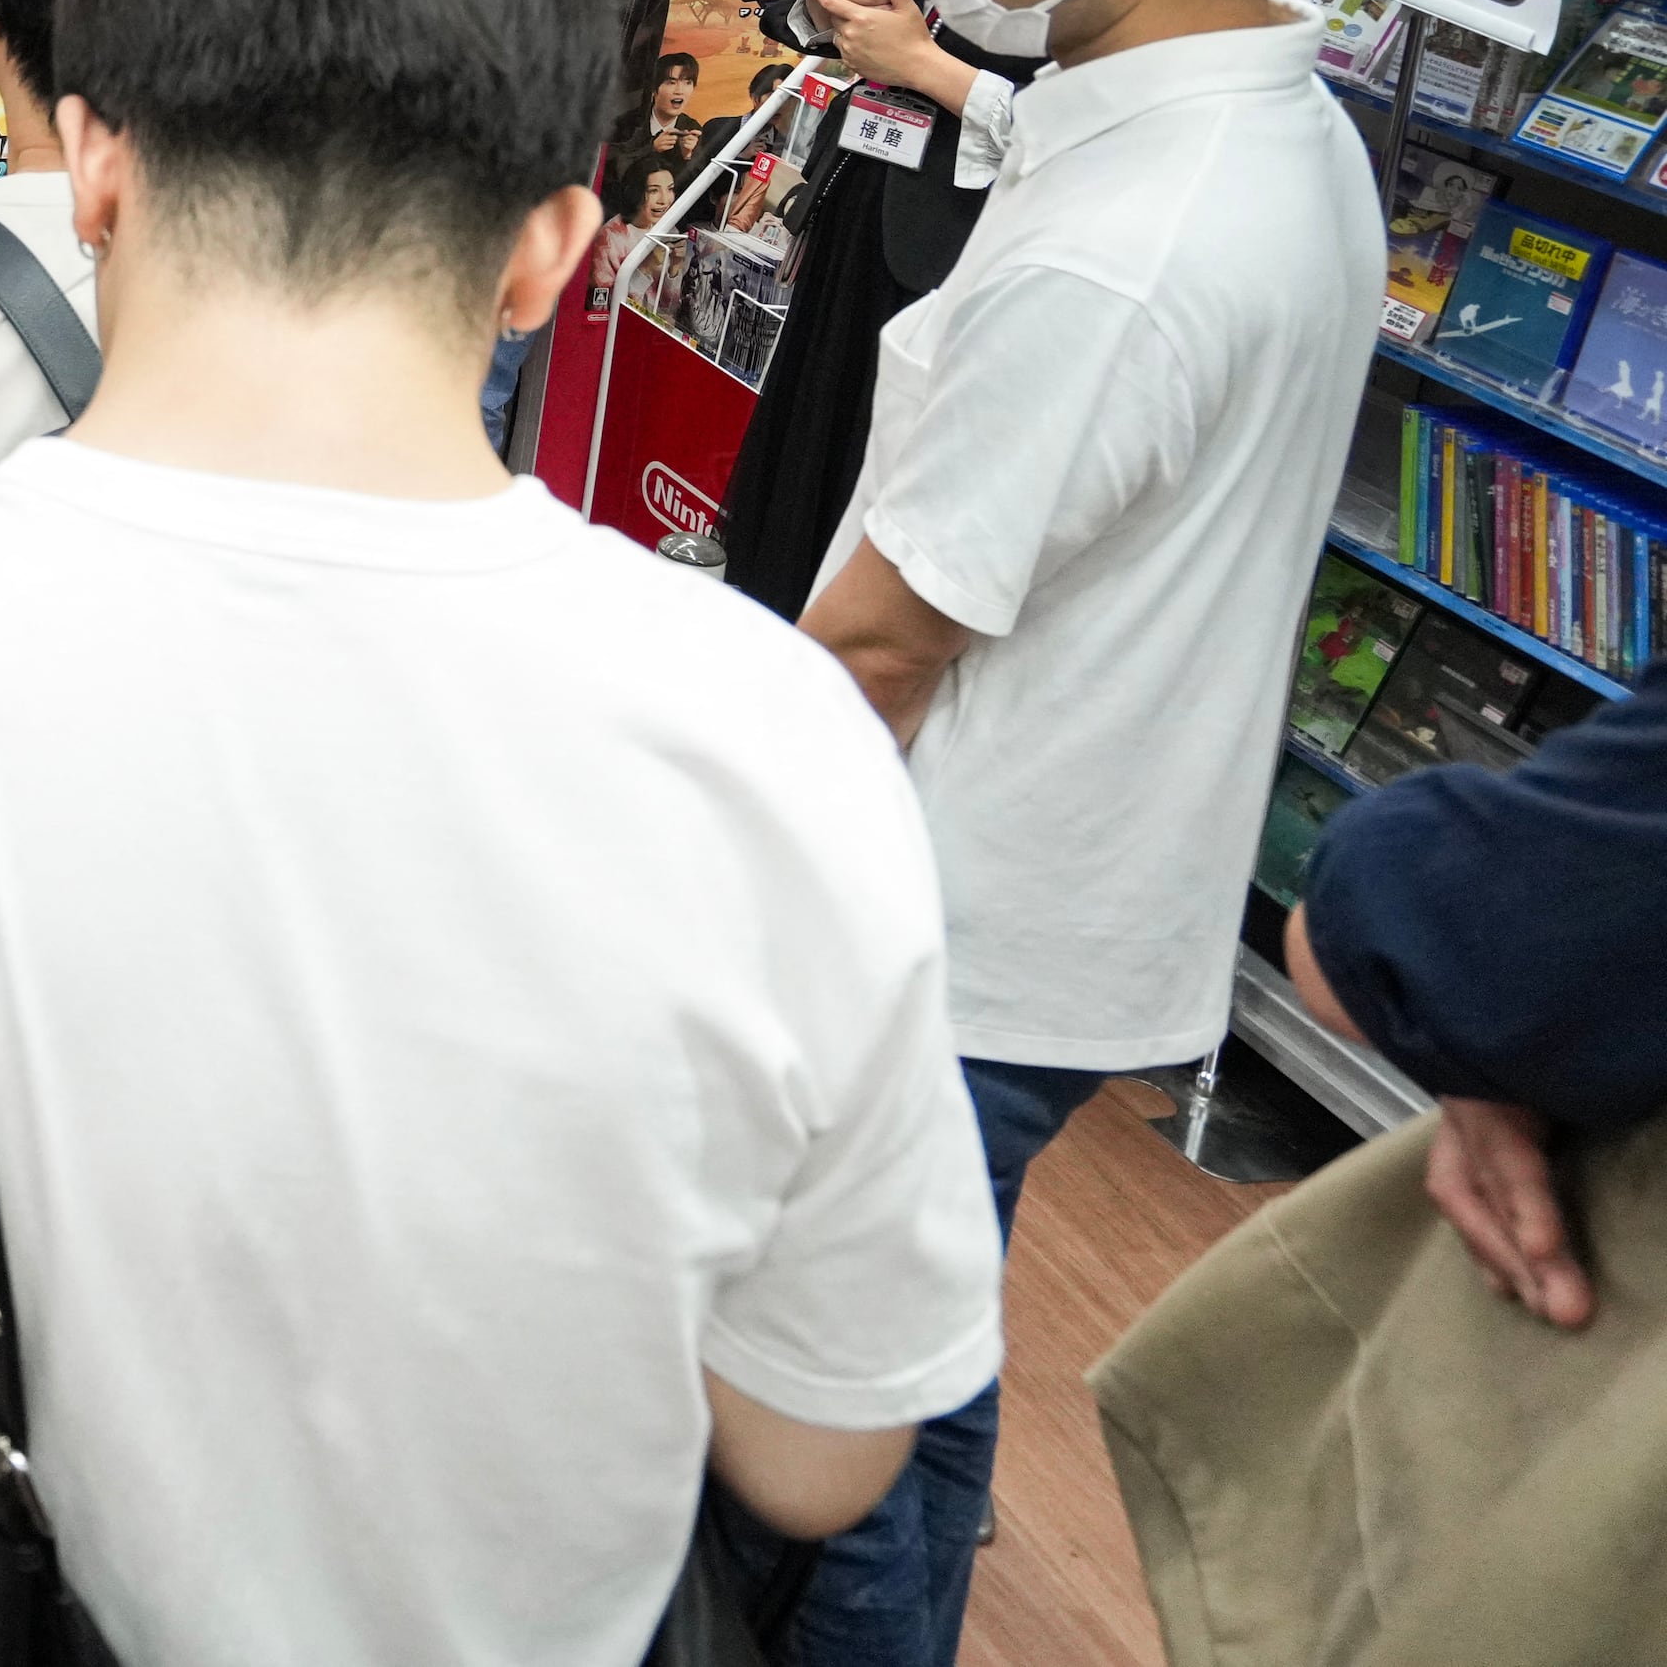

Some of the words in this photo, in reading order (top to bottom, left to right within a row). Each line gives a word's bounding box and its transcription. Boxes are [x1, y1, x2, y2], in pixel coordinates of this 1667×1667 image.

[862, 142, 890, 158] Harima
[1520, 233, 1576, 263] 品切れ中
